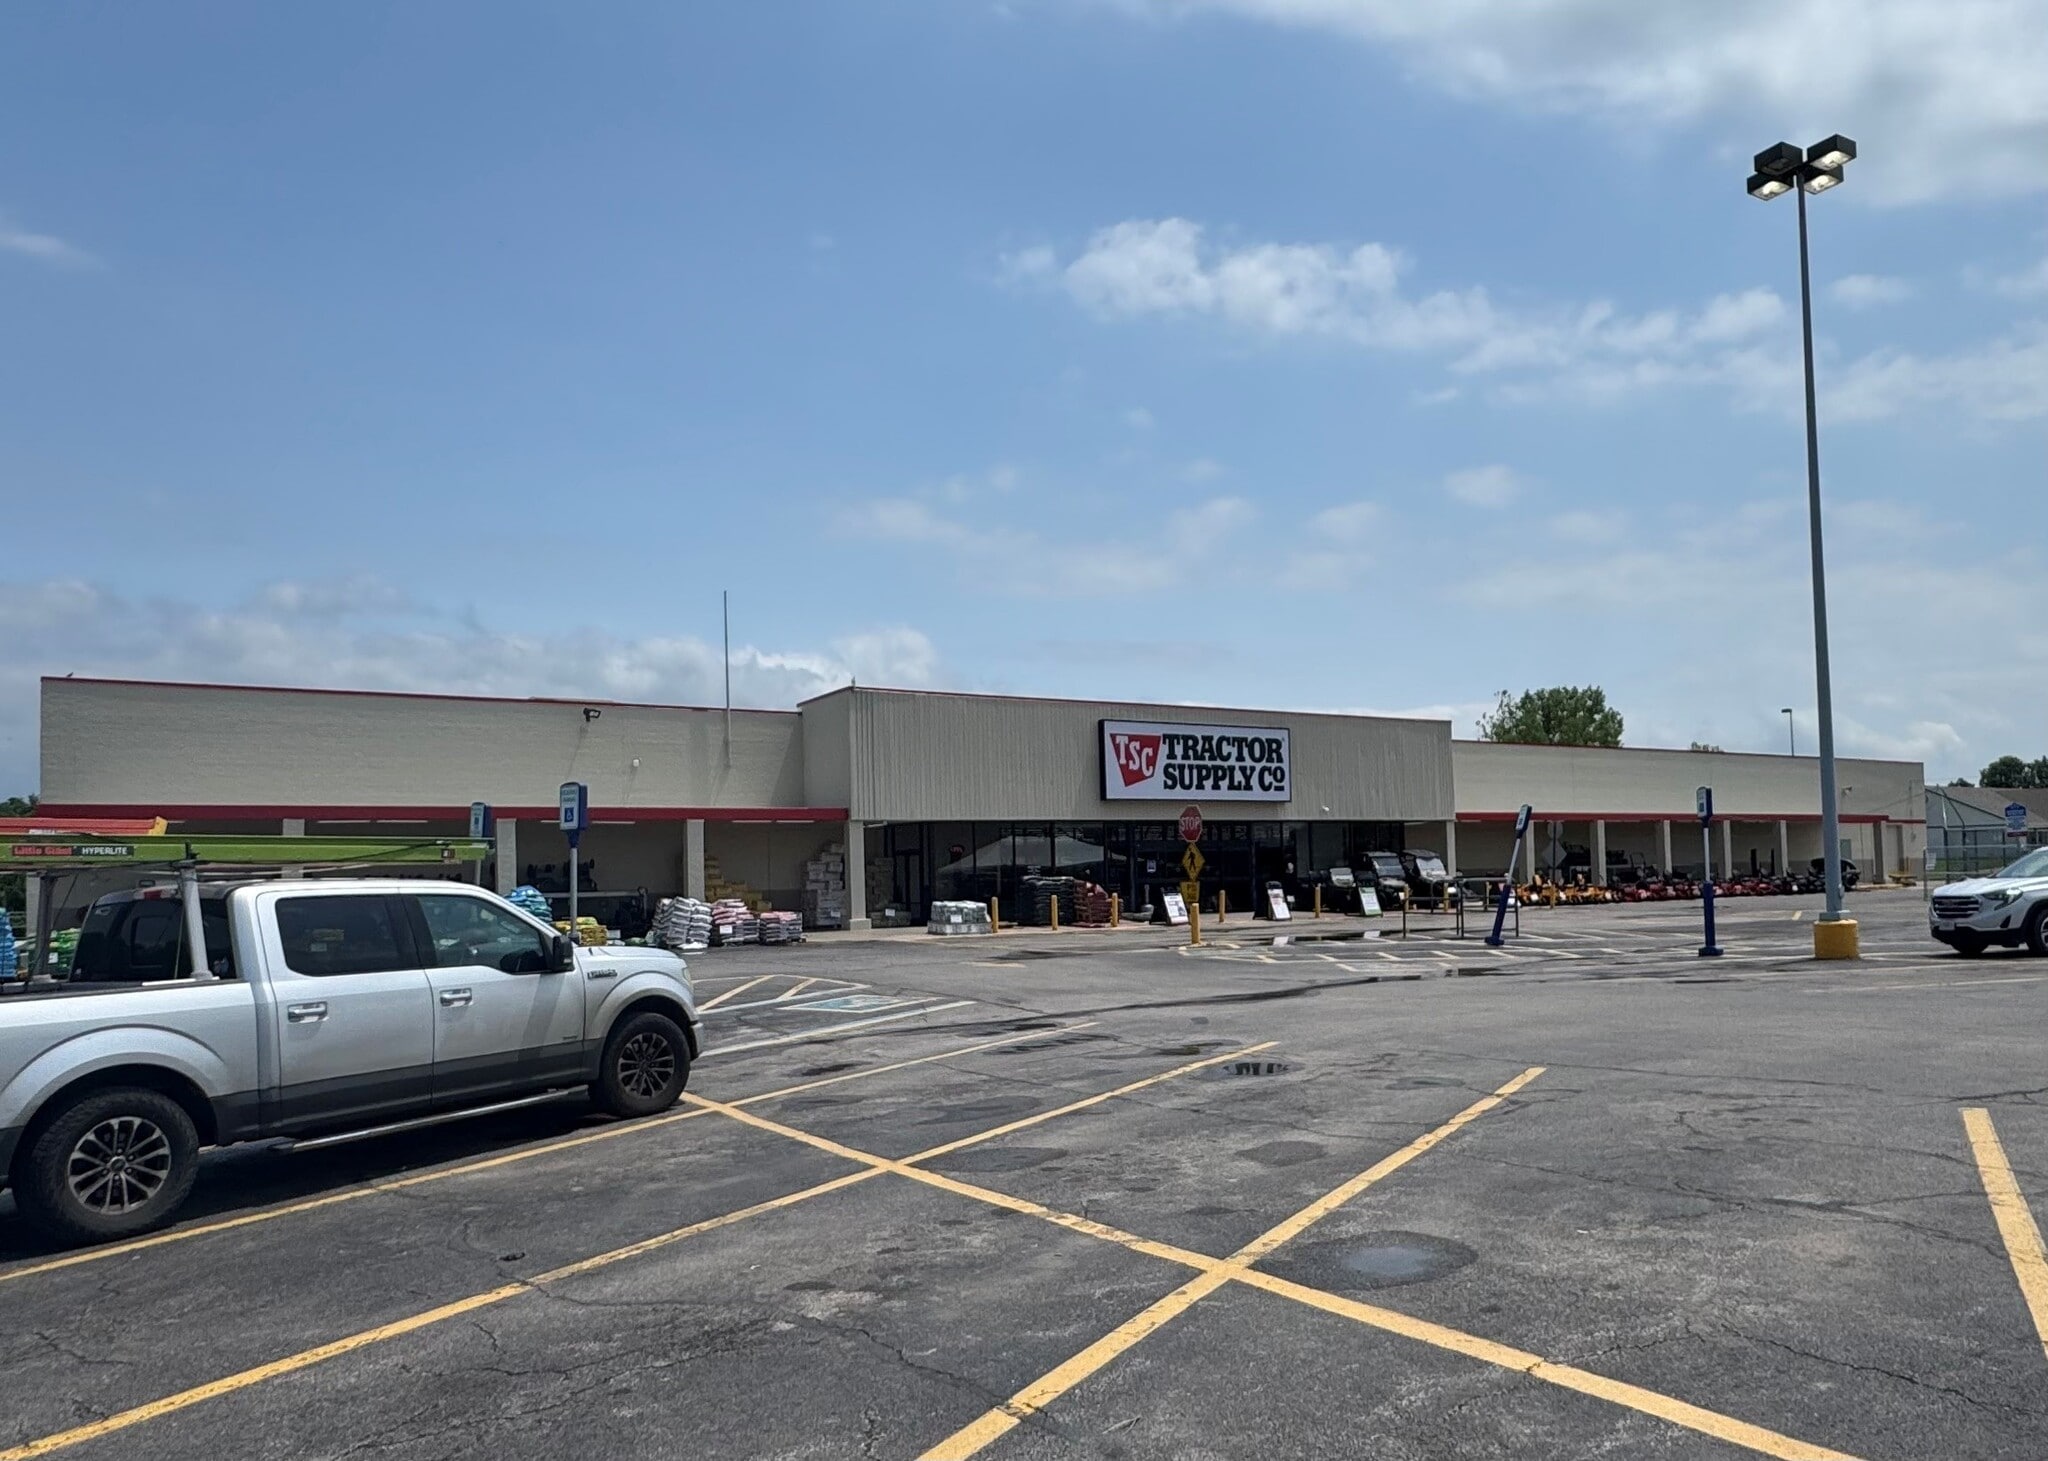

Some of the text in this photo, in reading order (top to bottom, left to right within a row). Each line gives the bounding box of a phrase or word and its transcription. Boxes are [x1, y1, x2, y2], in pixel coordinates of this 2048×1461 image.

[1116, 735, 1153, 777] TSC
[1162, 733, 1284, 763] TRACTOR
[1163, 763, 1255, 791] SUPPLY
[1181, 817, 1201, 832] STOP
[82, 847, 127, 855] HYPERLITE
